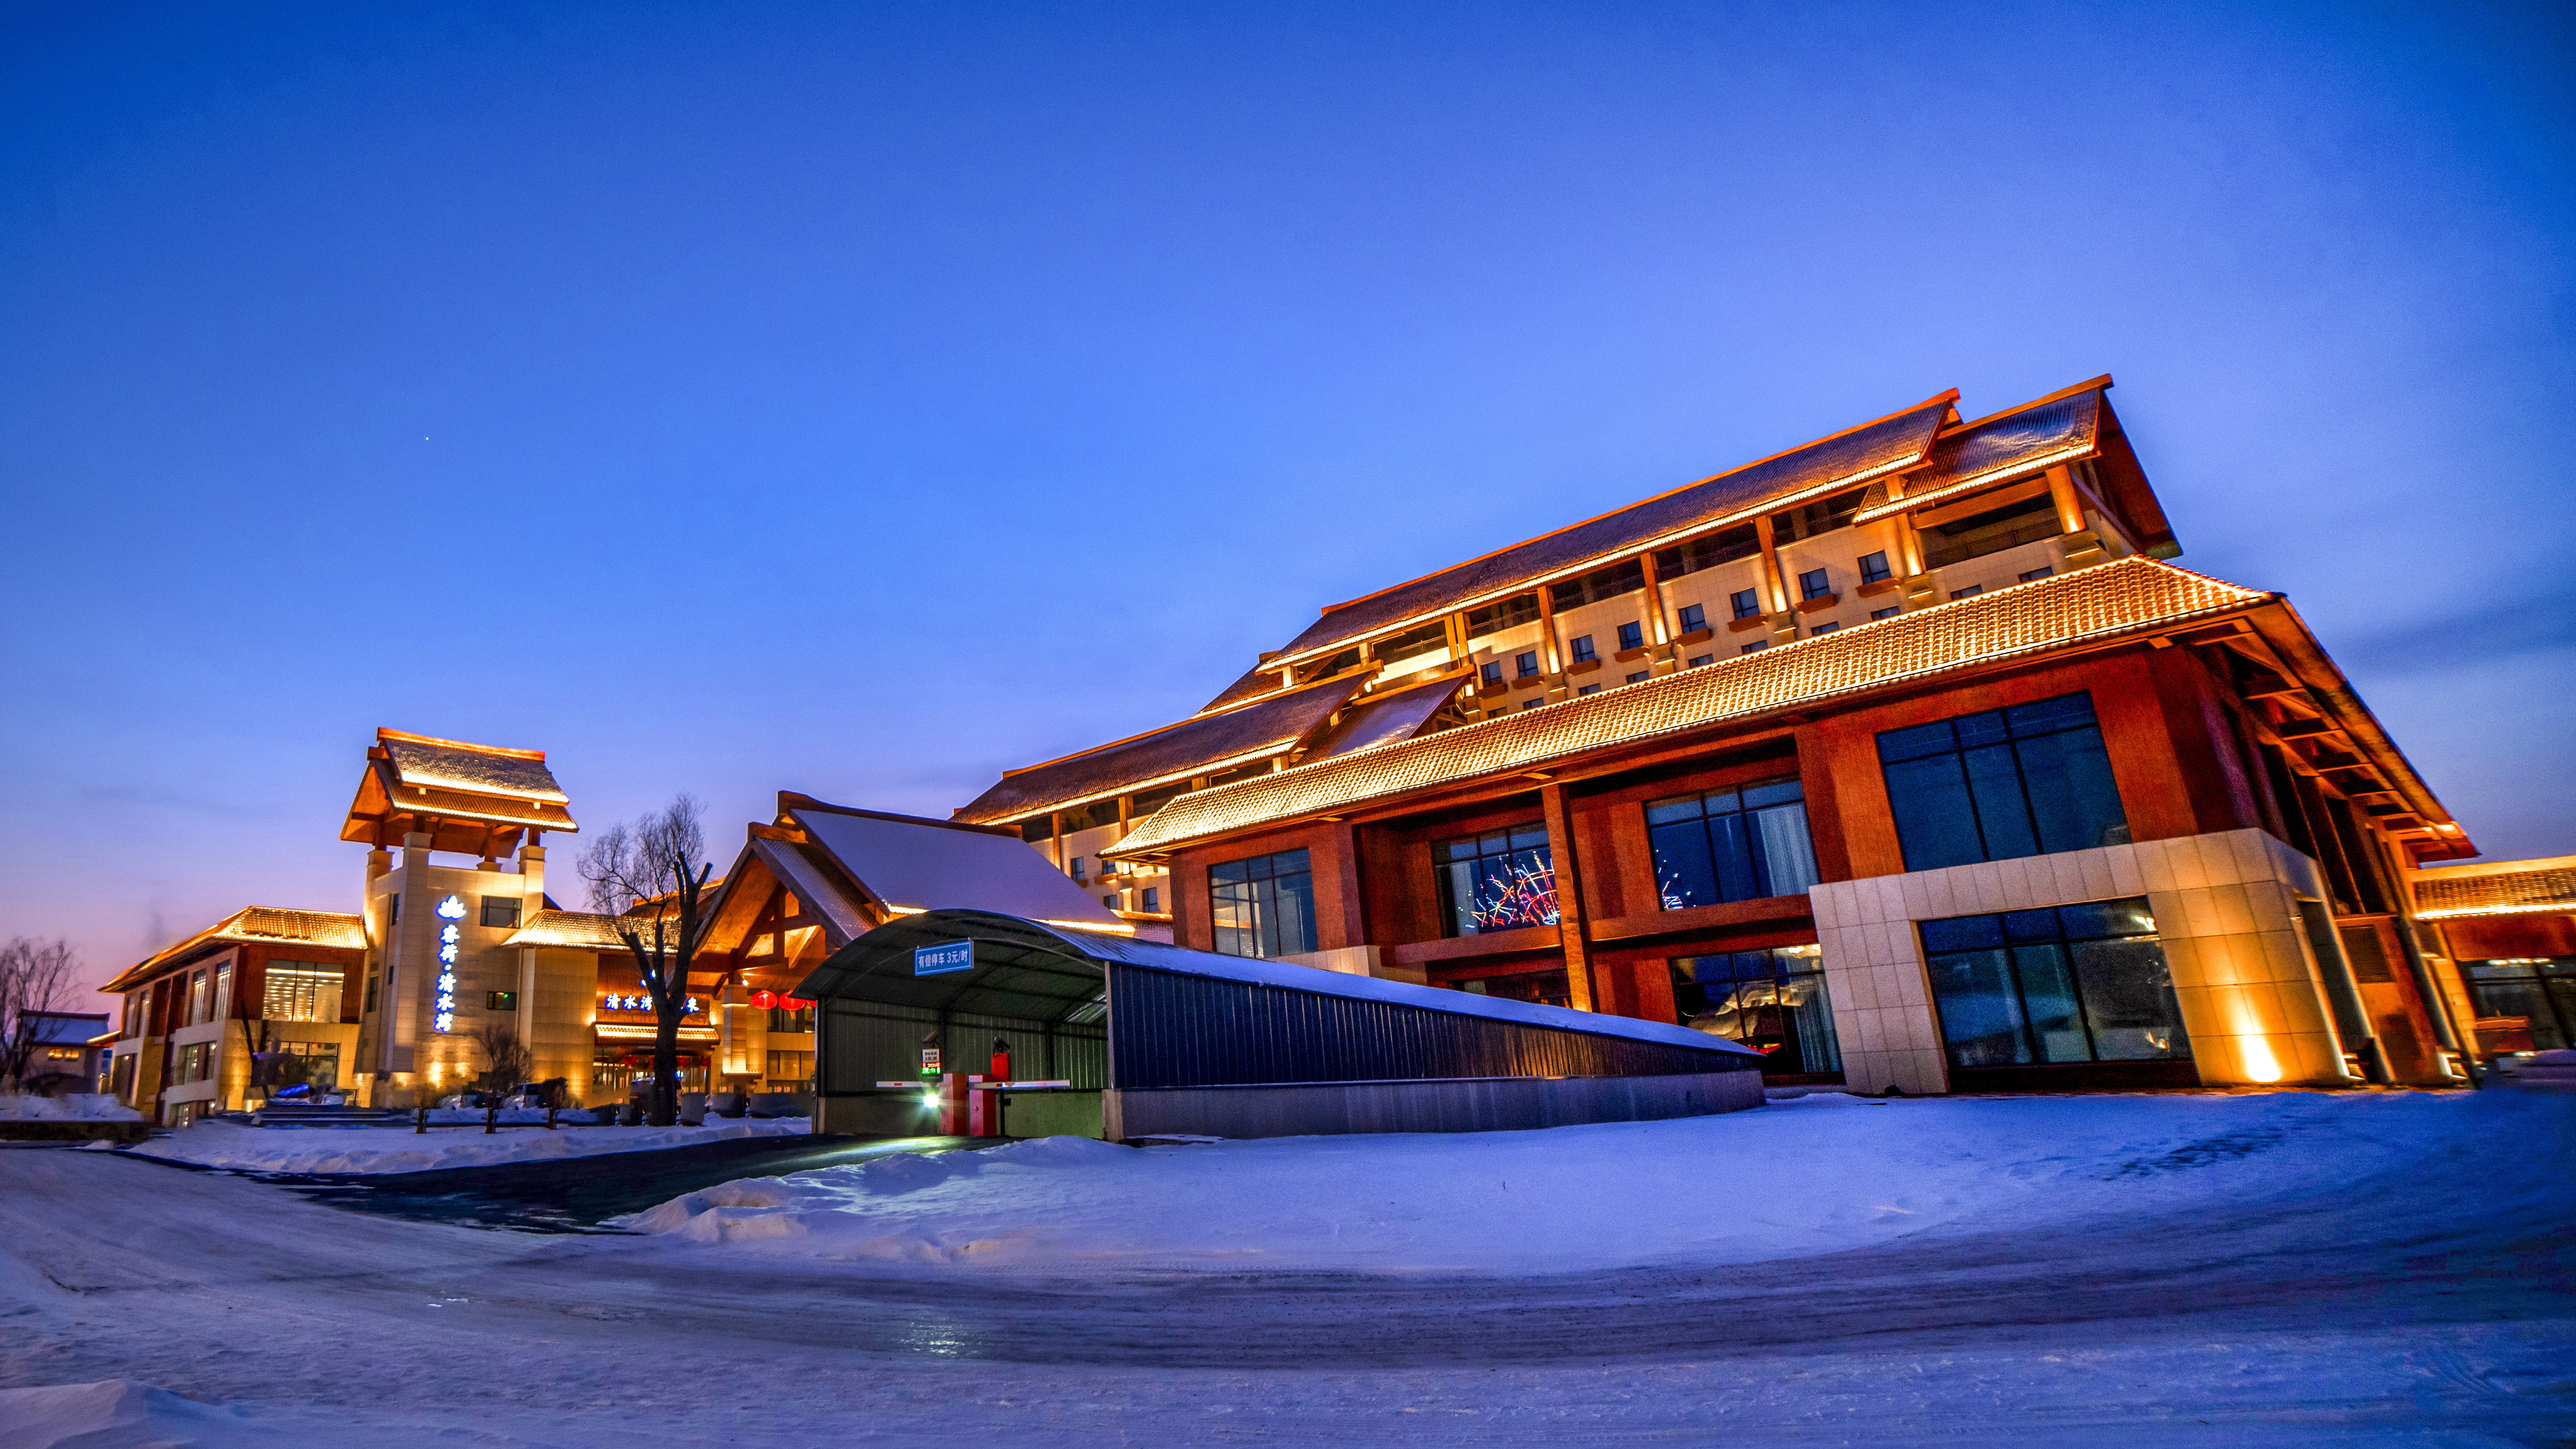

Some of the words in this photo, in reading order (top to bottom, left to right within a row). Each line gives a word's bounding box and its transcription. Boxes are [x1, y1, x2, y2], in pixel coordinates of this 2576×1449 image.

[918, 953, 945, 969] 有偿停车
[947, 949, 968, 964] 3元/时
